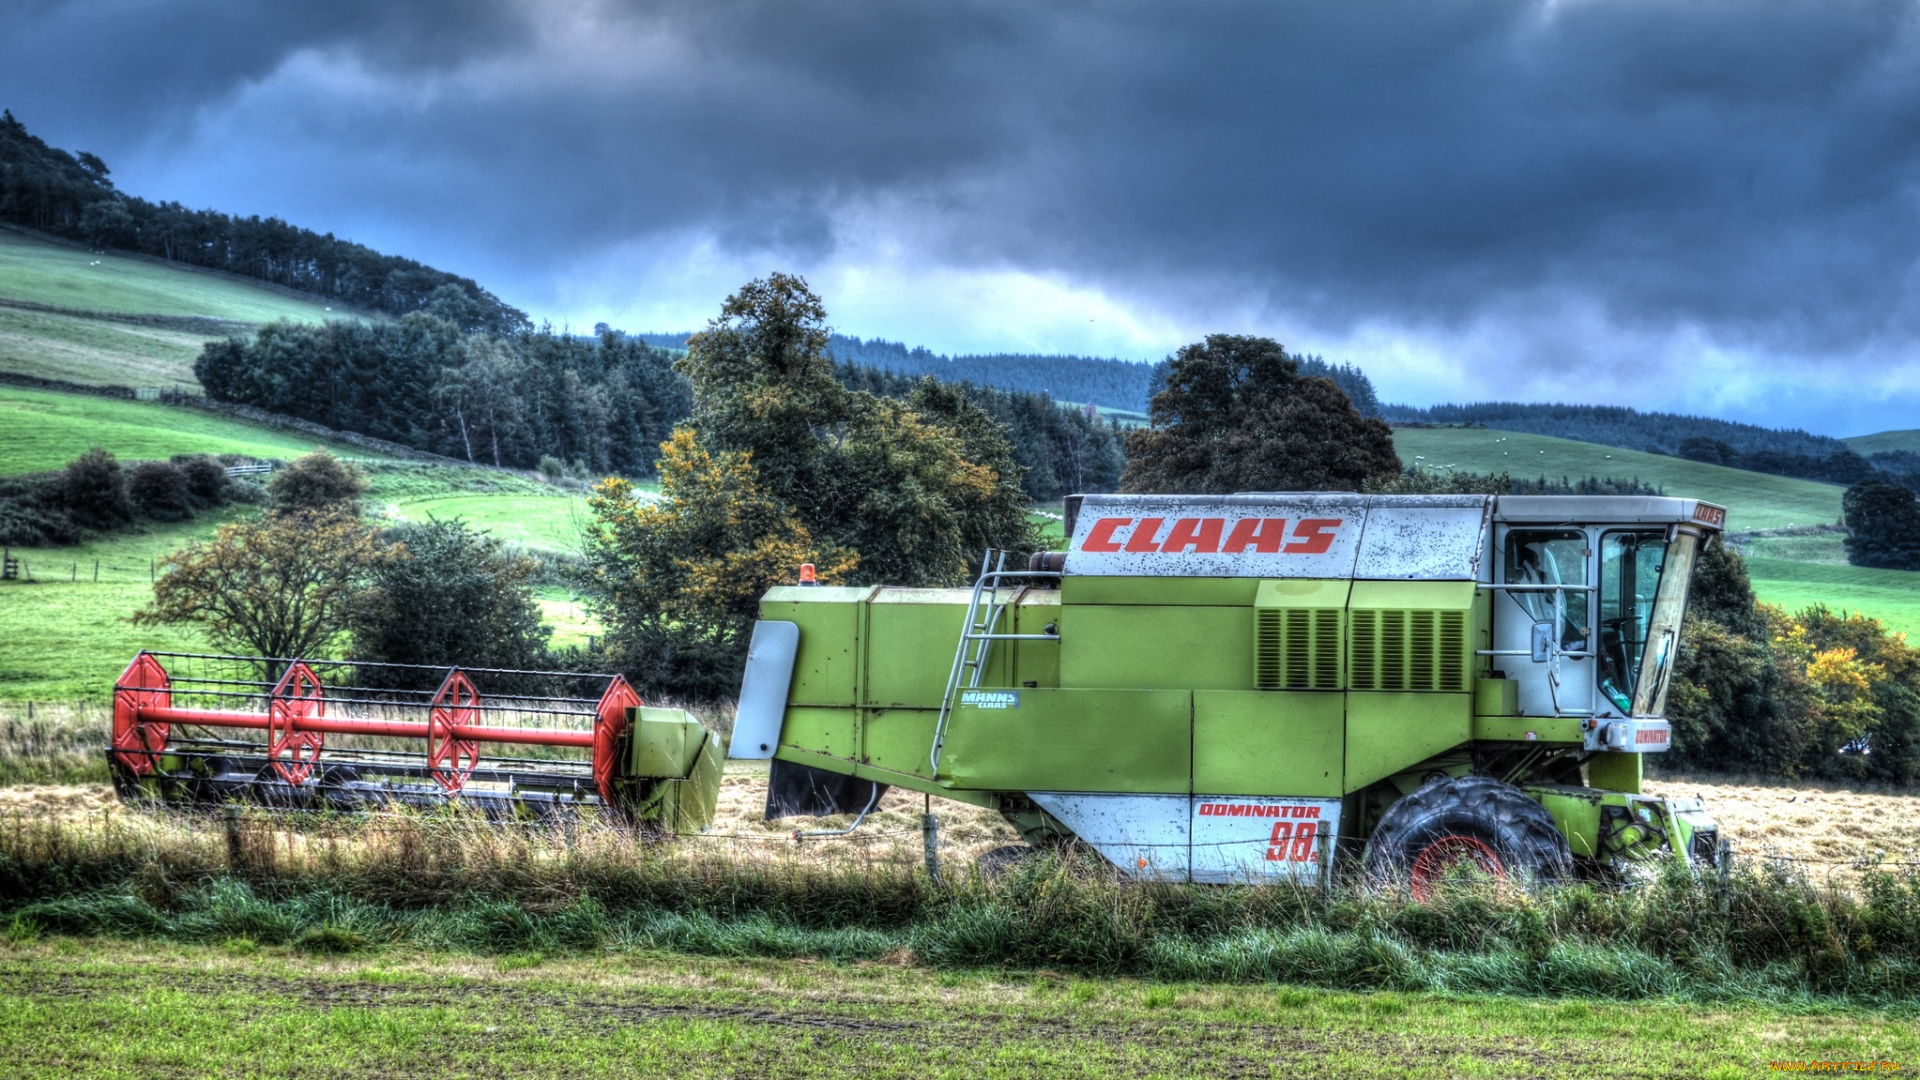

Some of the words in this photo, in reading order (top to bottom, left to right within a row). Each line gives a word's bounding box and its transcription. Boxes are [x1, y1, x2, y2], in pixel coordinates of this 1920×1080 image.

[1081, 517, 1343, 554] CLAAS
[1635, 729, 1668, 744] DOMINATOR
[1199, 803, 1321, 819] DOMINATOR
